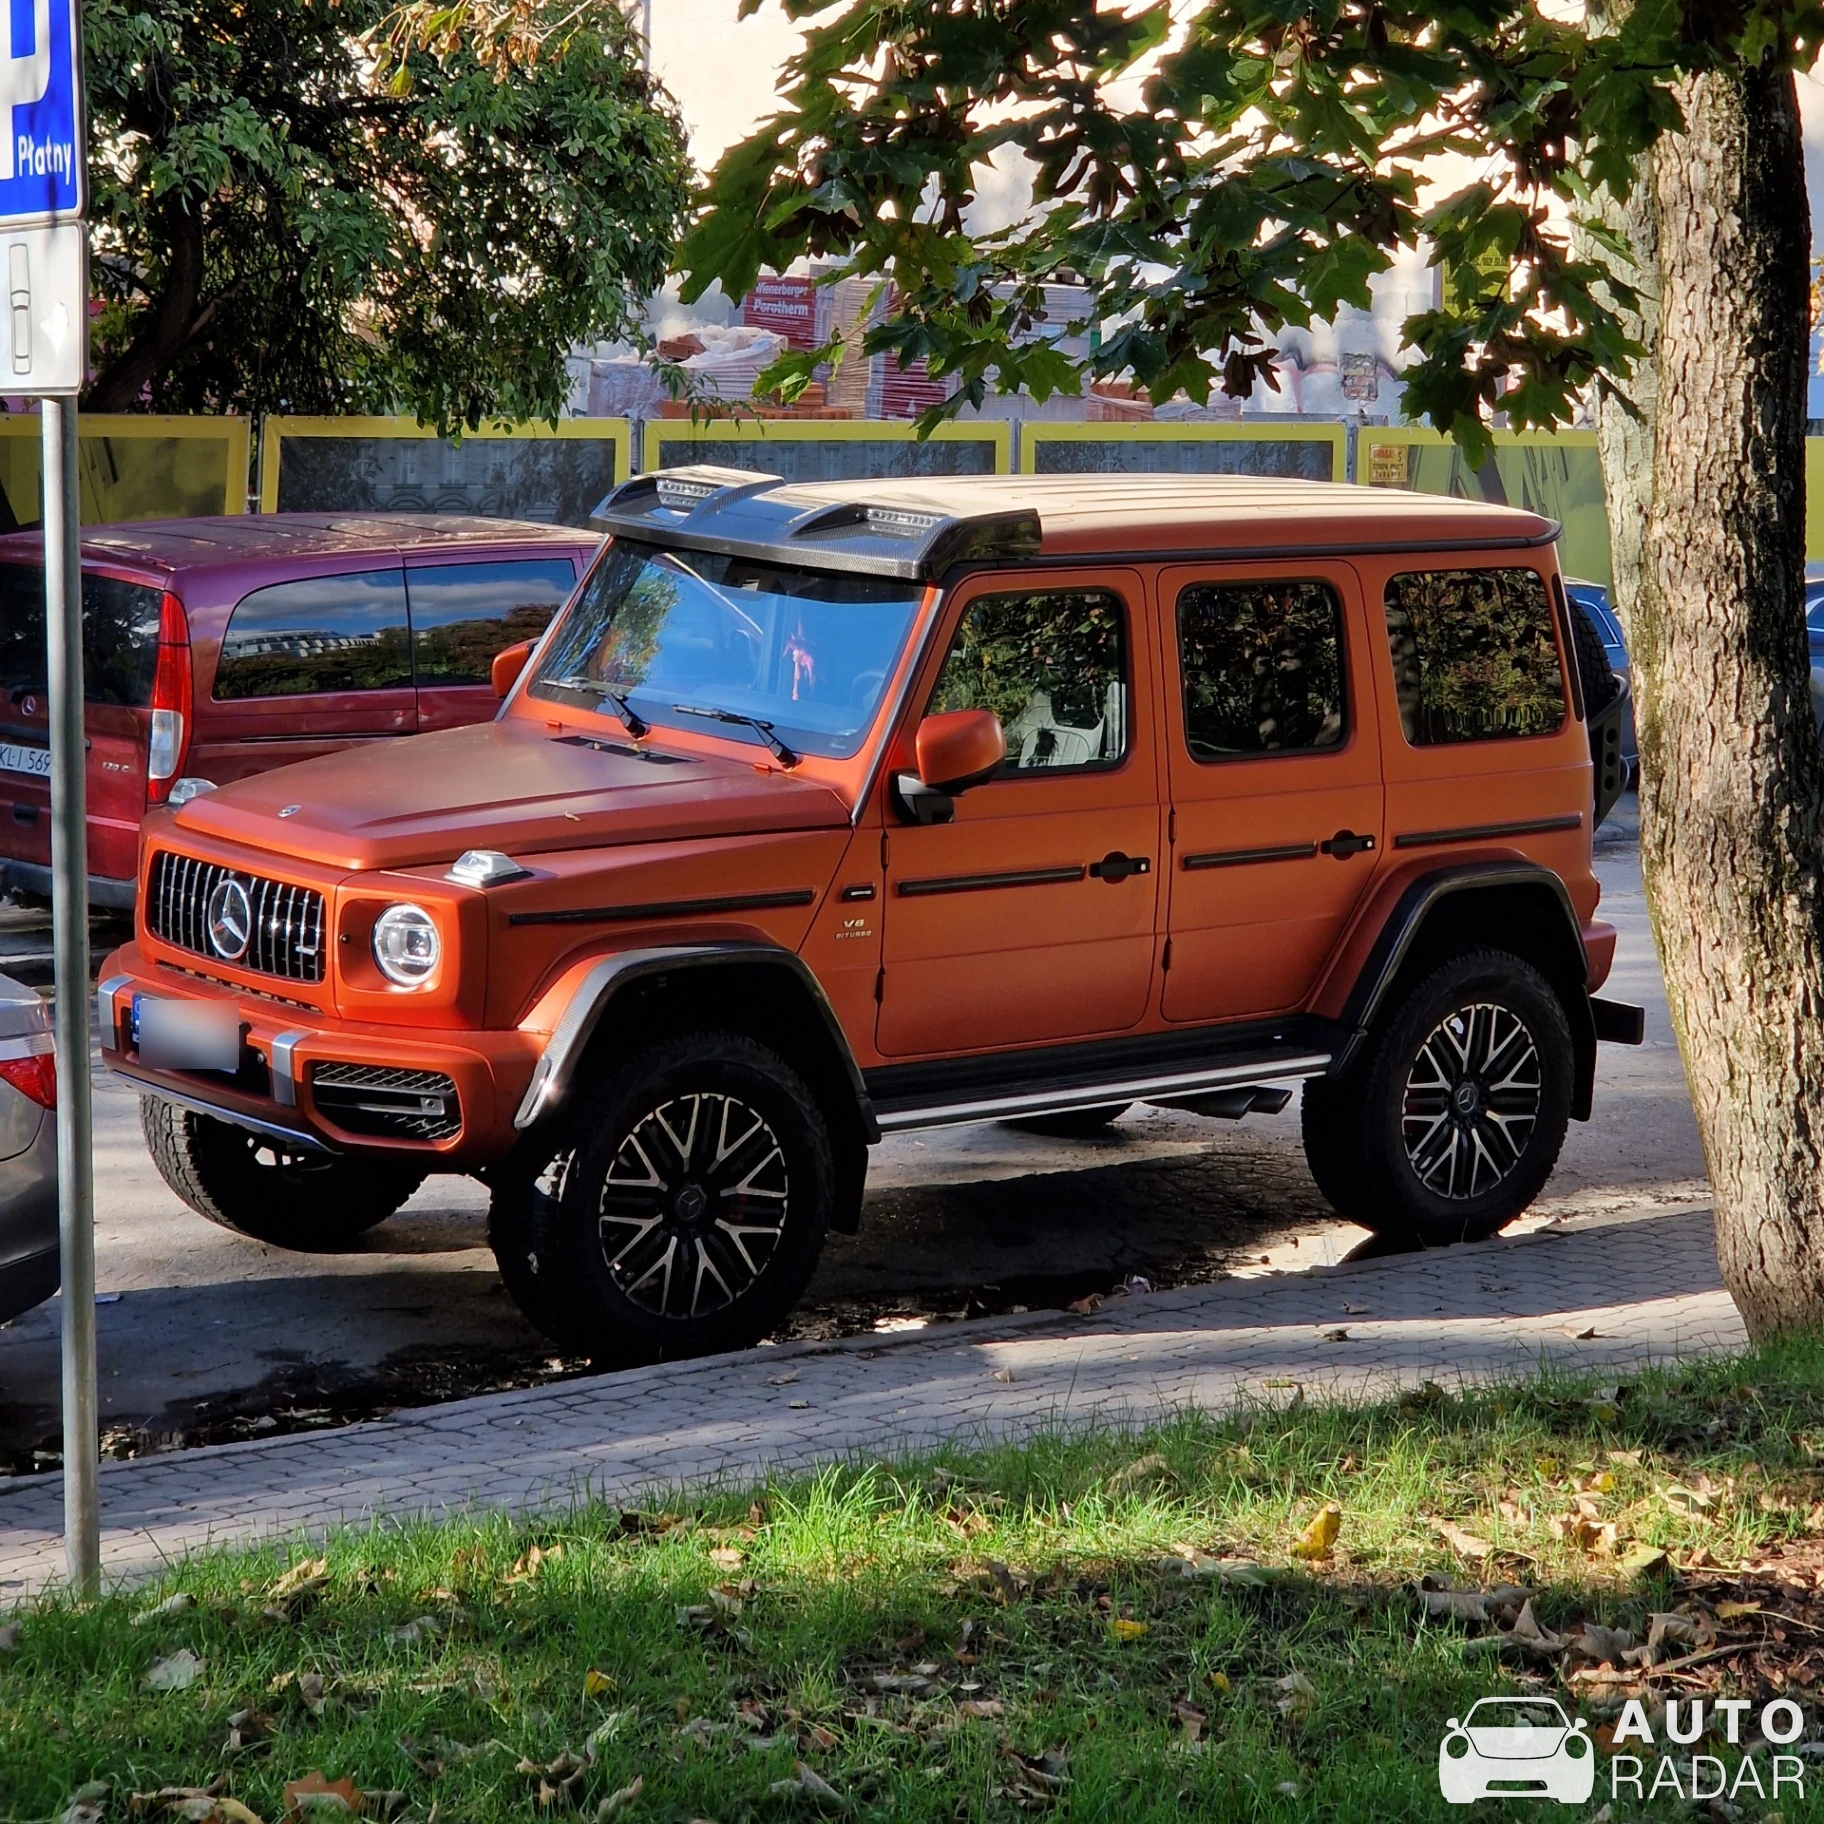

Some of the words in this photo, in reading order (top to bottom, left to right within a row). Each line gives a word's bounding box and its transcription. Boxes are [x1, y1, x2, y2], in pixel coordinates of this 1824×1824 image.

[18, 135, 71, 185] Płatny
[755, 282, 809, 298] Wienerberger
[753, 298, 809, 316] Porotherm
[843, 919, 865, 928] V8
[835, 930, 872, 940] BITURBO
